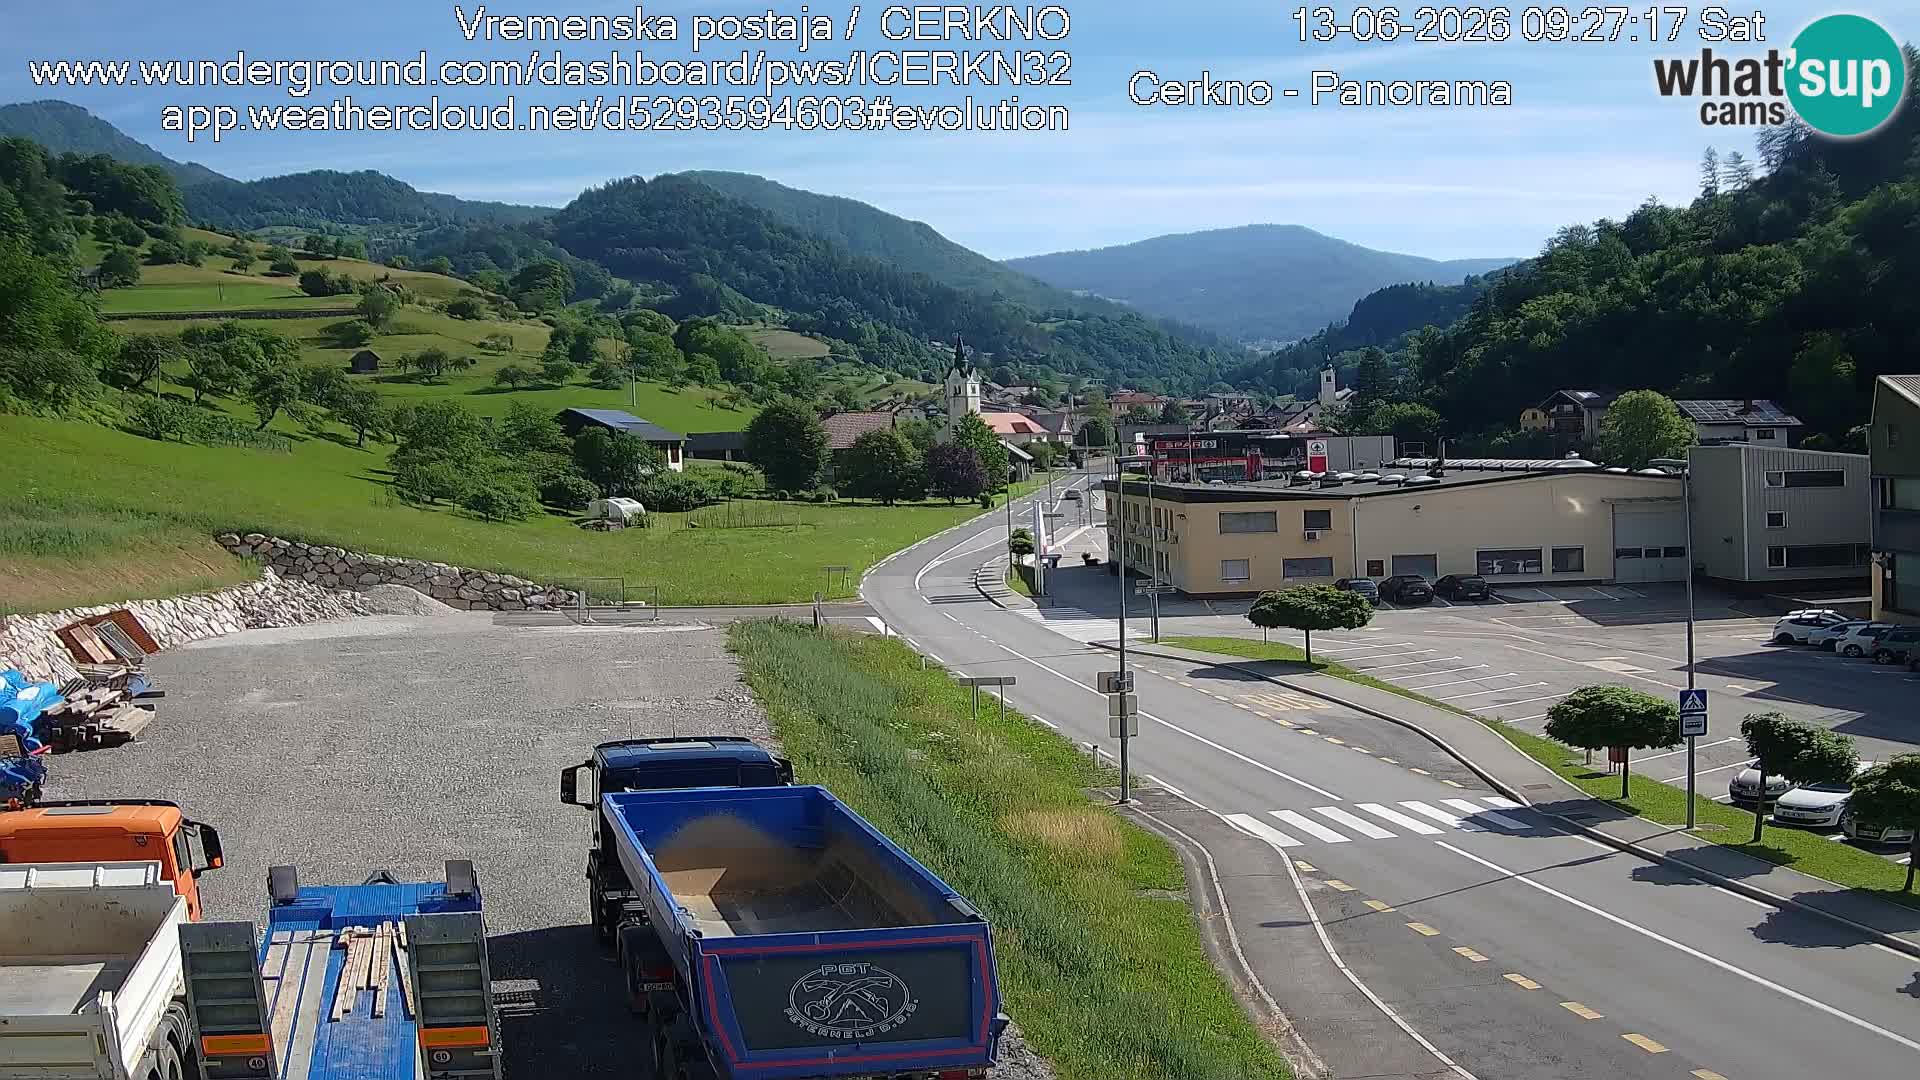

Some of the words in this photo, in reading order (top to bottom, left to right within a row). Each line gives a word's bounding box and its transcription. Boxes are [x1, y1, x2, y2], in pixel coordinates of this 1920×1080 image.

[1166, 441, 1201, 449] SPAR
[821, 962, 871, 976] PGT
[435, 1053, 448, 1061] 60
